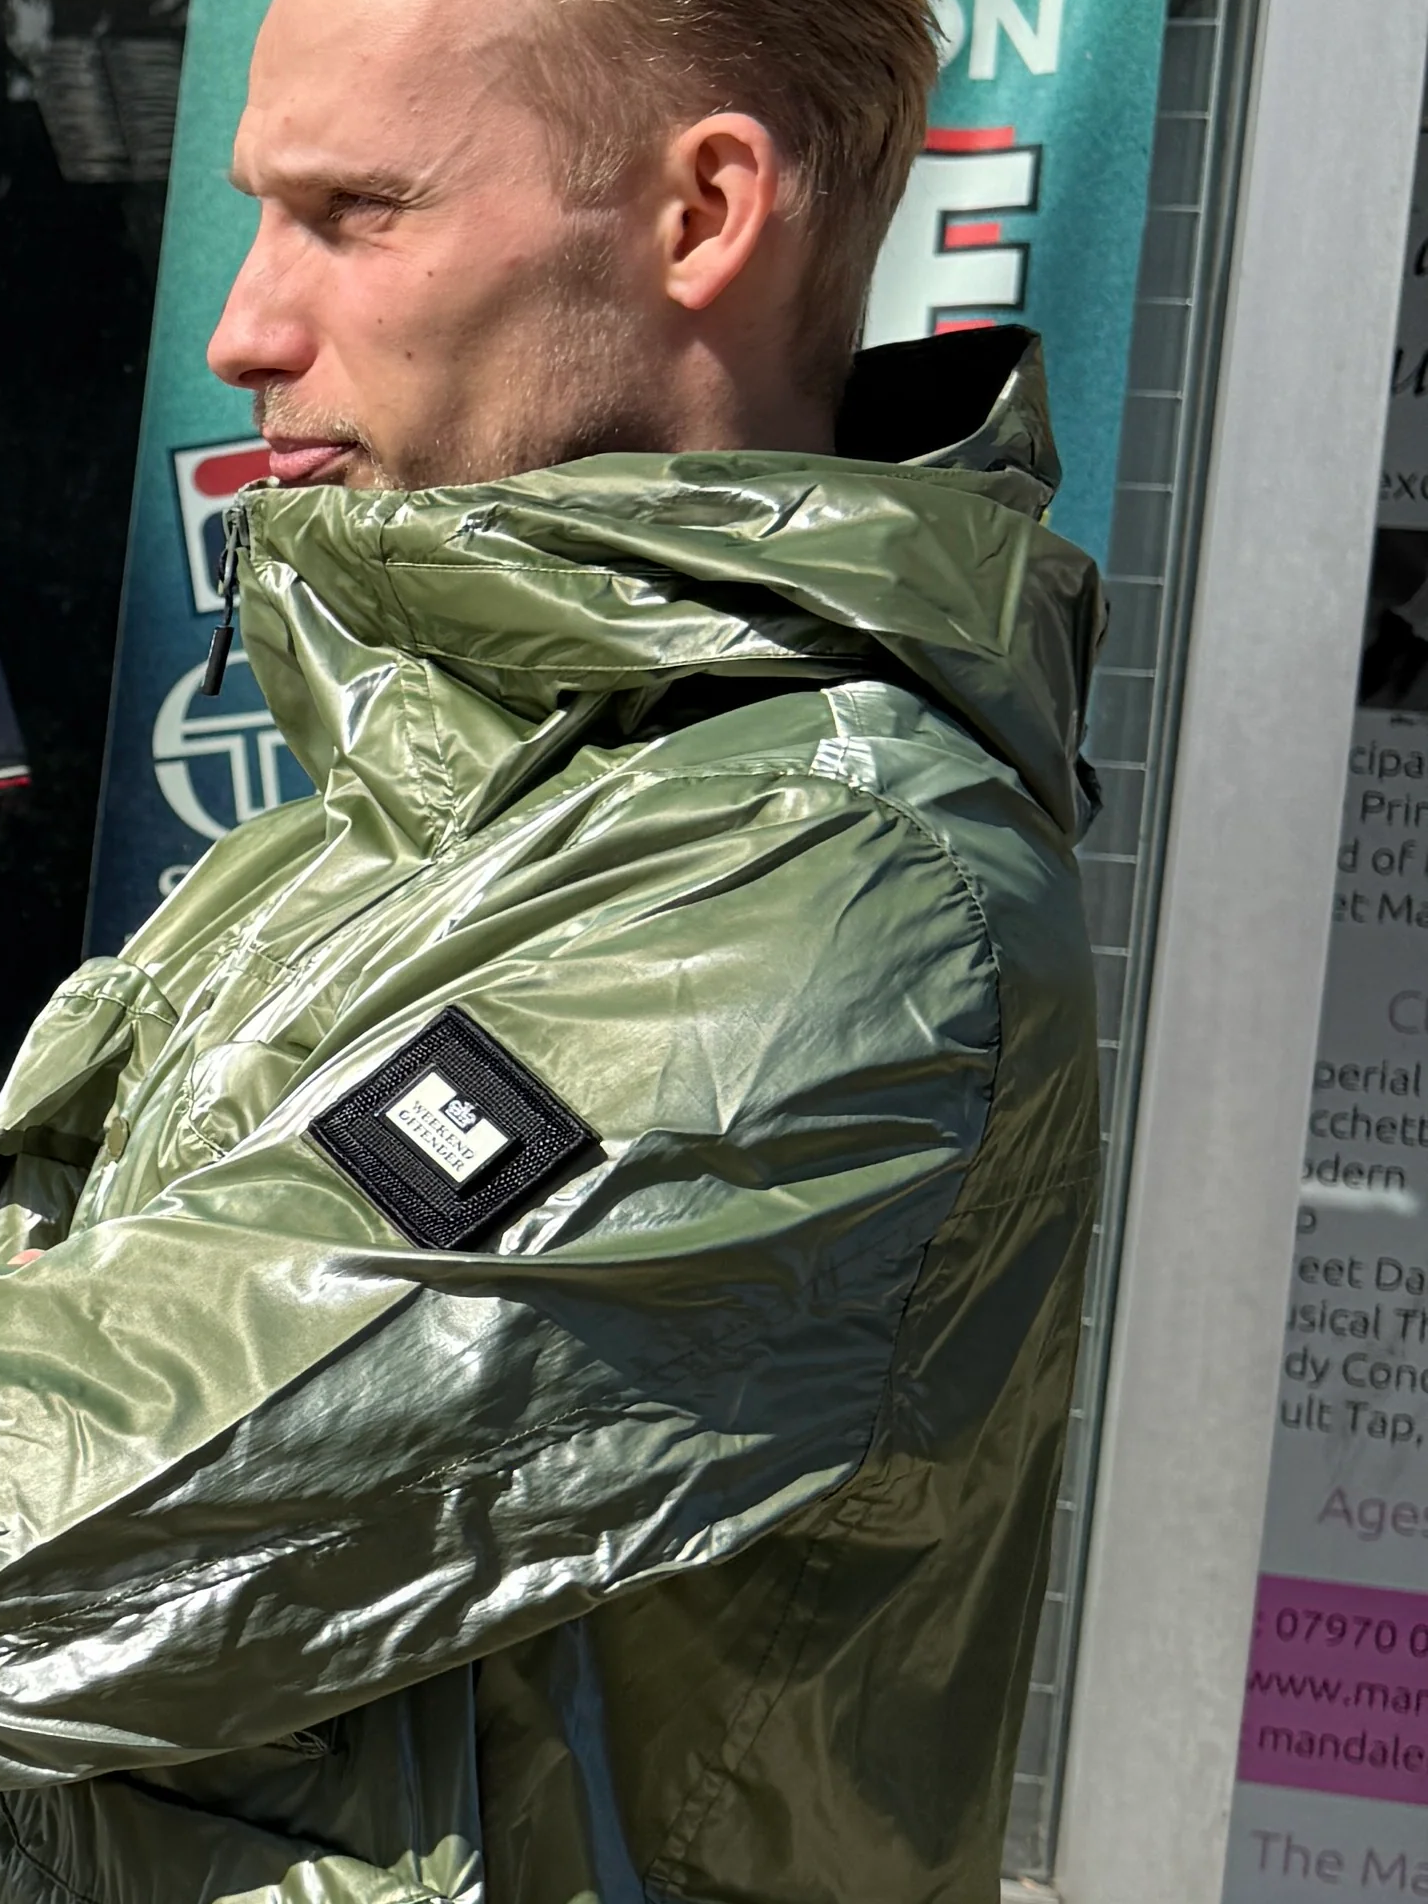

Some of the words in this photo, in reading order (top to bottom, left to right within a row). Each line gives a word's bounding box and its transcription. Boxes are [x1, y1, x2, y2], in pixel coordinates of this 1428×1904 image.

[398, 1109, 466, 1173] OFFENDER
[412, 1100, 476, 1160] WEEKEND
[1276, 1607, 1398, 1655] 07970
[1250, 1827, 1345, 1886] The
